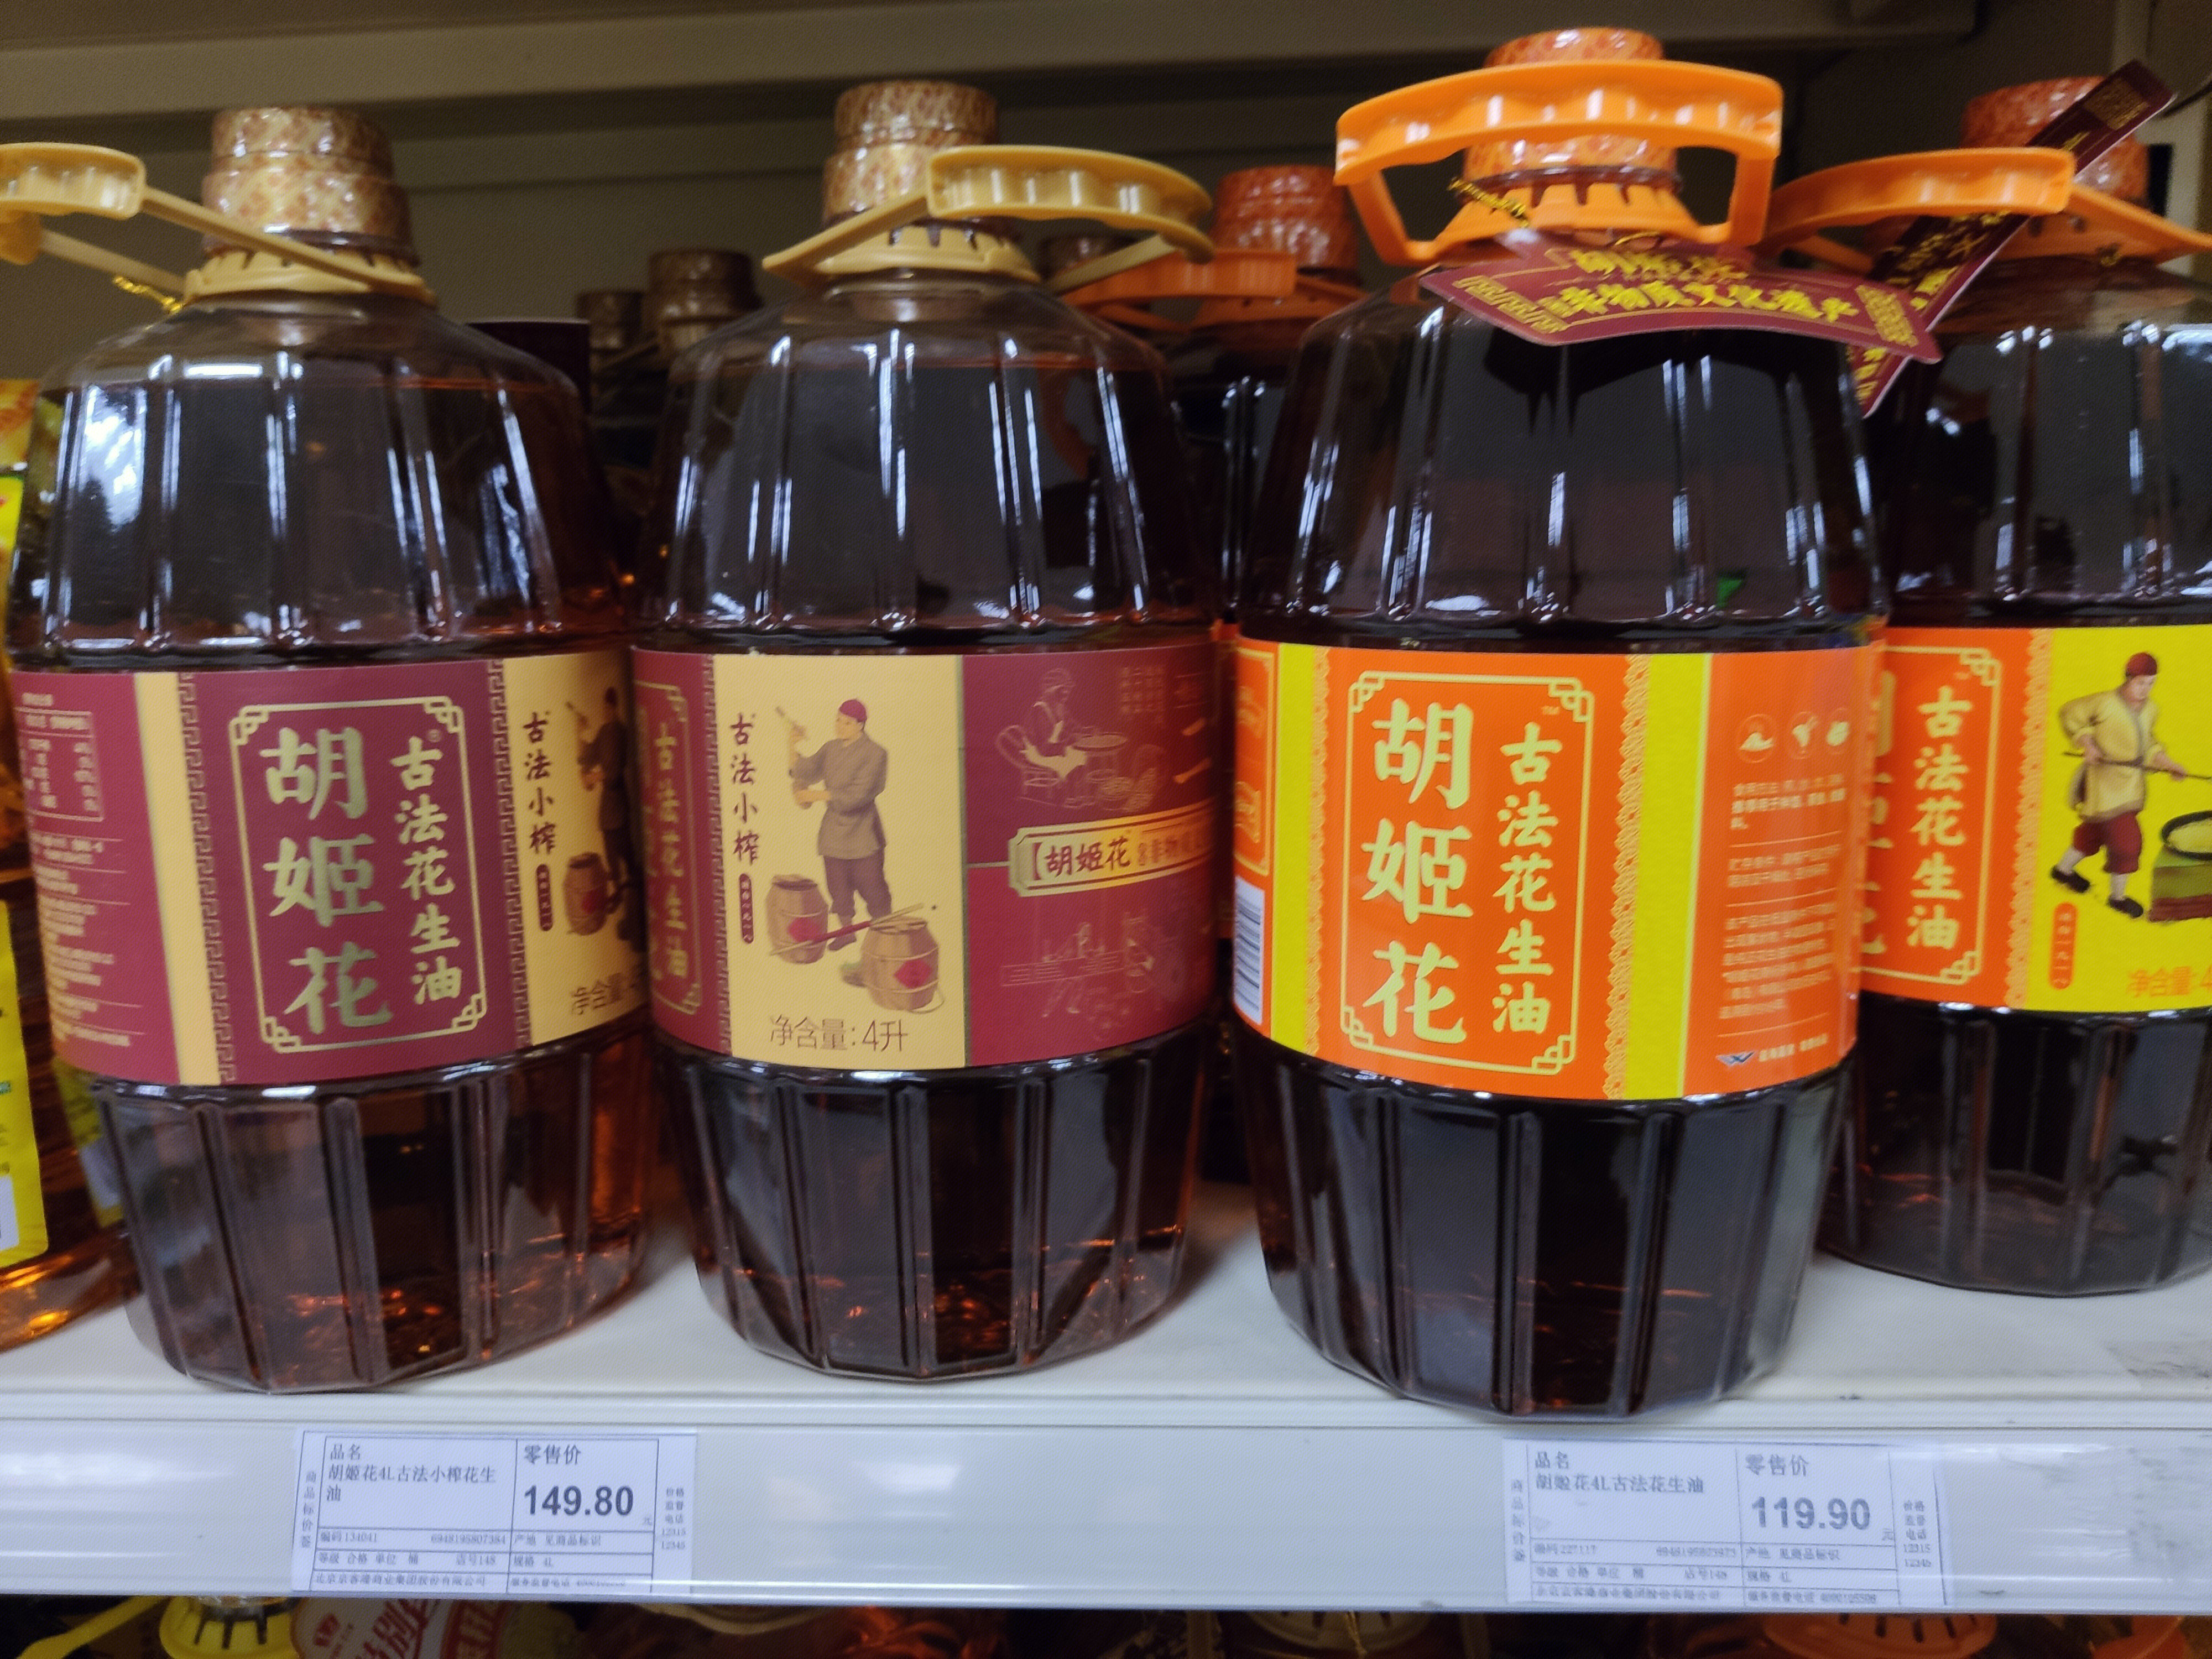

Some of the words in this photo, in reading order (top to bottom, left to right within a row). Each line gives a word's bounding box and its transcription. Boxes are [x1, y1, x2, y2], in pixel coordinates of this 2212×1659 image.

[524, 712, 556, 855] 古法小榨
[730, 712, 759, 866] 古法小榨
[1906, 686, 1973, 950] 古法花生油
[259, 727, 393, 1035] 胡姬花
[390, 735, 462, 1005] 古法花生油
[1361, 697, 1474, 1044] 胡姬花
[1492, 722, 1563, 1034] 古法花生油
[770, 1015, 907, 1052] 净含量:4升
[331, 1444, 360, 1460] 品名
[524, 1444, 581, 1464] 零售价
[1535, 1451, 1569, 1469] 品名
[1745, 1454, 1808, 1477] 零售价
[329, 1464, 495, 1483] 胡姬花4L古法小榨花生
[327, 1484, 341, 1501] 油
[524, 1485, 633, 1515] 149.80
[1752, 1496, 1870, 1530] 119.90
